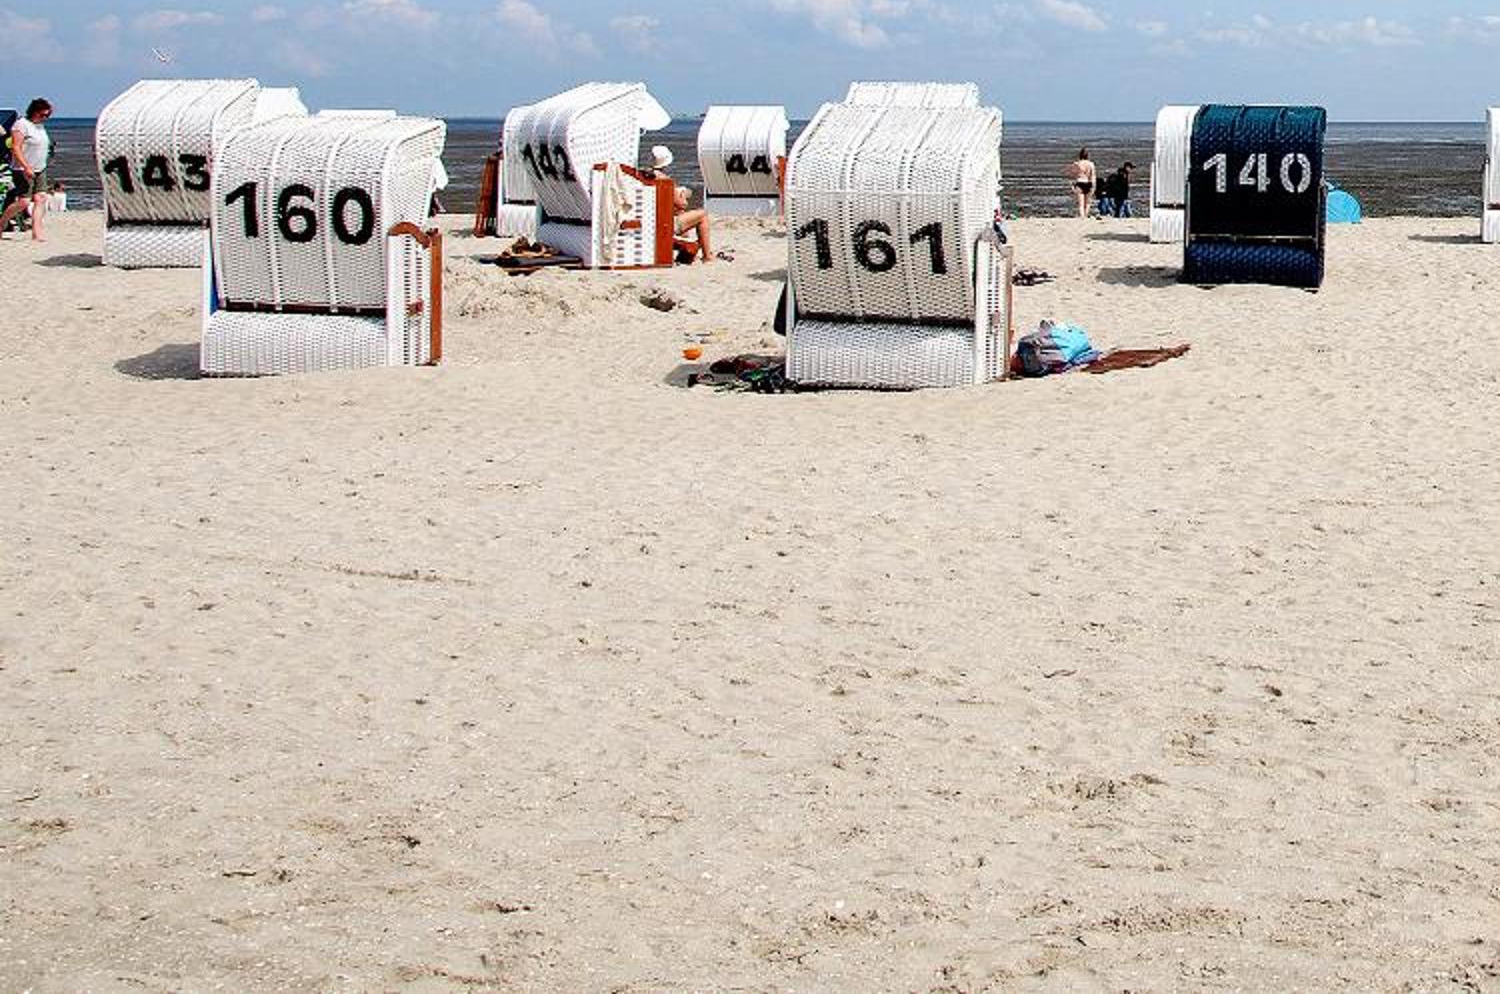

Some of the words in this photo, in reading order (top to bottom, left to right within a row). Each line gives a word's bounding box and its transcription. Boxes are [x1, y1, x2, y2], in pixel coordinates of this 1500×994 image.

[103, 153, 211, 194] 143
[725, 153, 773, 175] 44
[1202, 152, 1313, 193] 140
[224, 181, 376, 247] 160
[793, 218, 948, 276] 161
